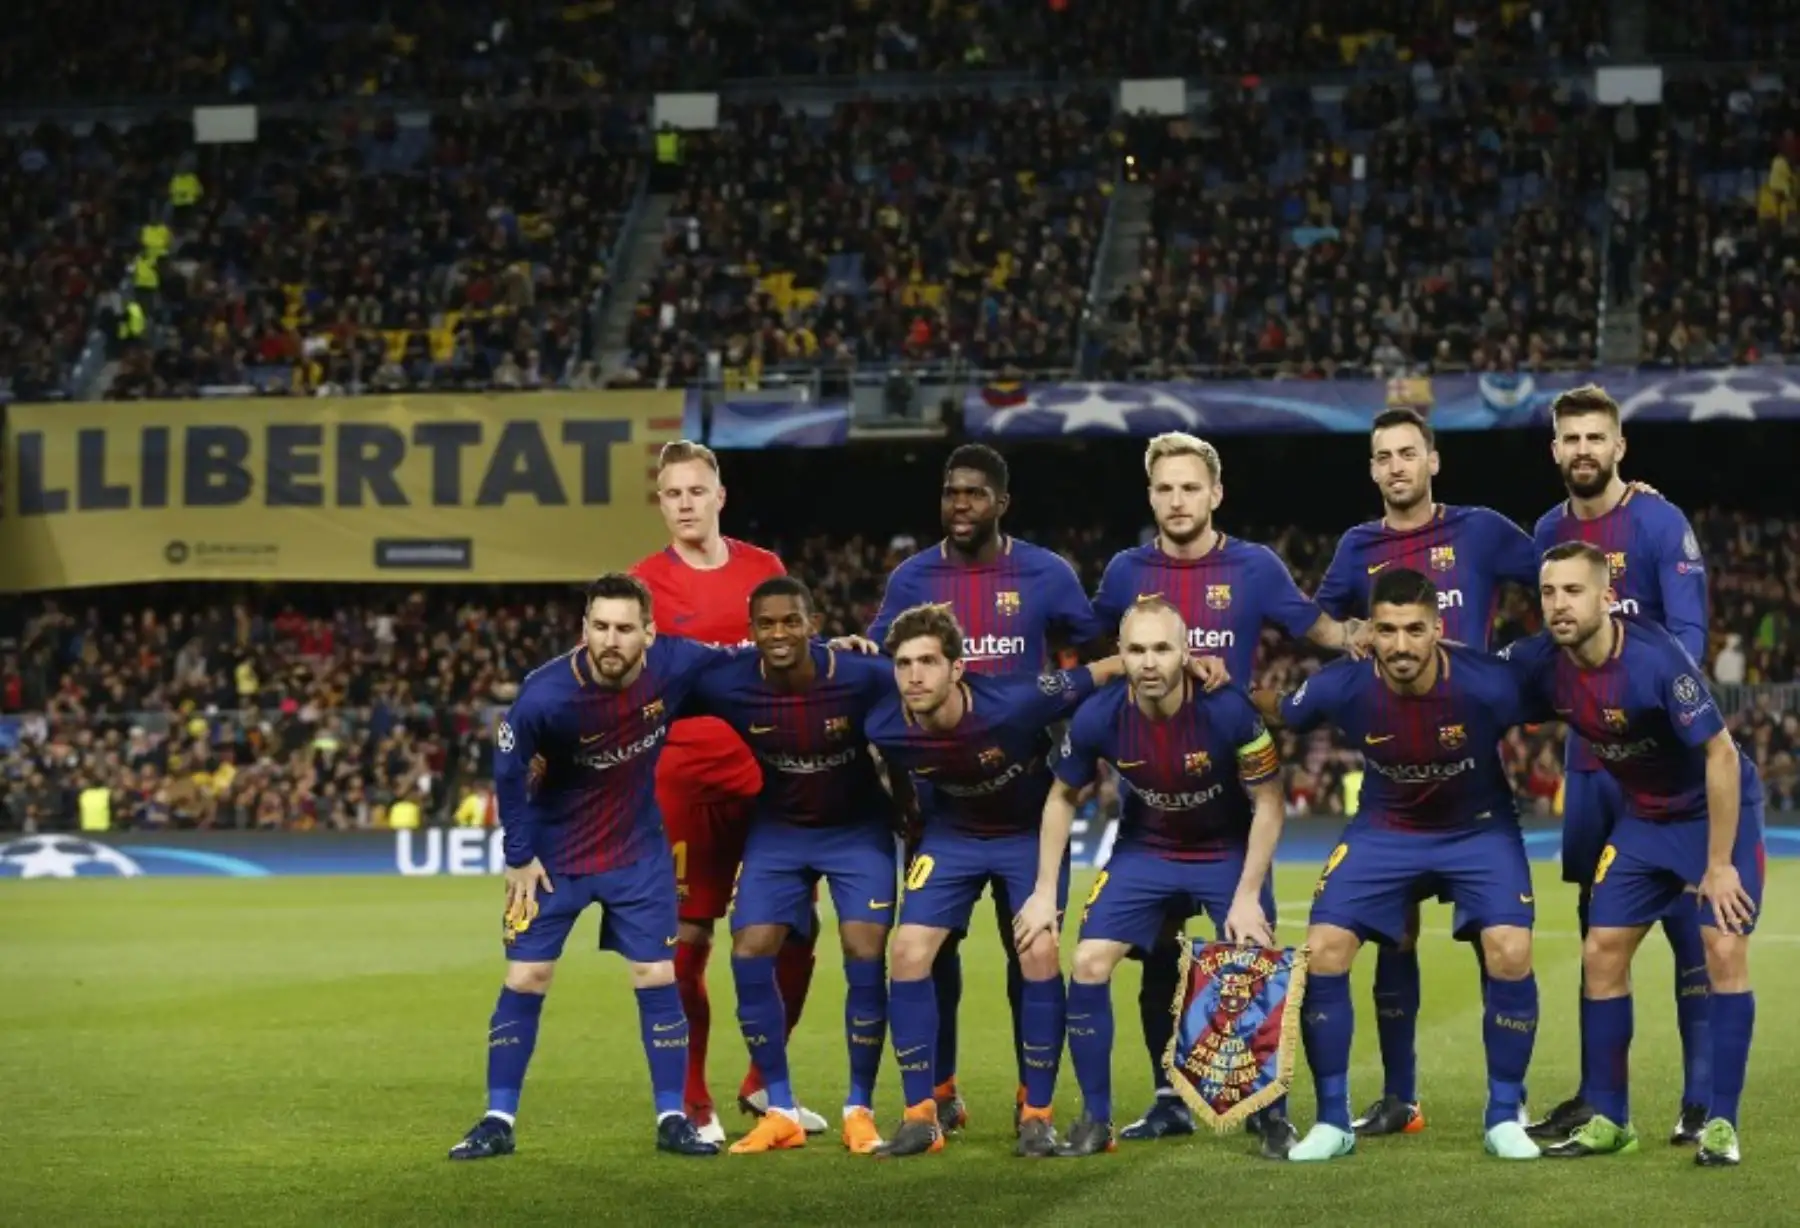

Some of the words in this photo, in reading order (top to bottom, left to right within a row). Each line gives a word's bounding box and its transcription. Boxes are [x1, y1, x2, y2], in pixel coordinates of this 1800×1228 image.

[17, 417, 633, 518] LLIBERTAT
[672, 841, 687, 880] 1
[906, 853, 935, 890] 0
